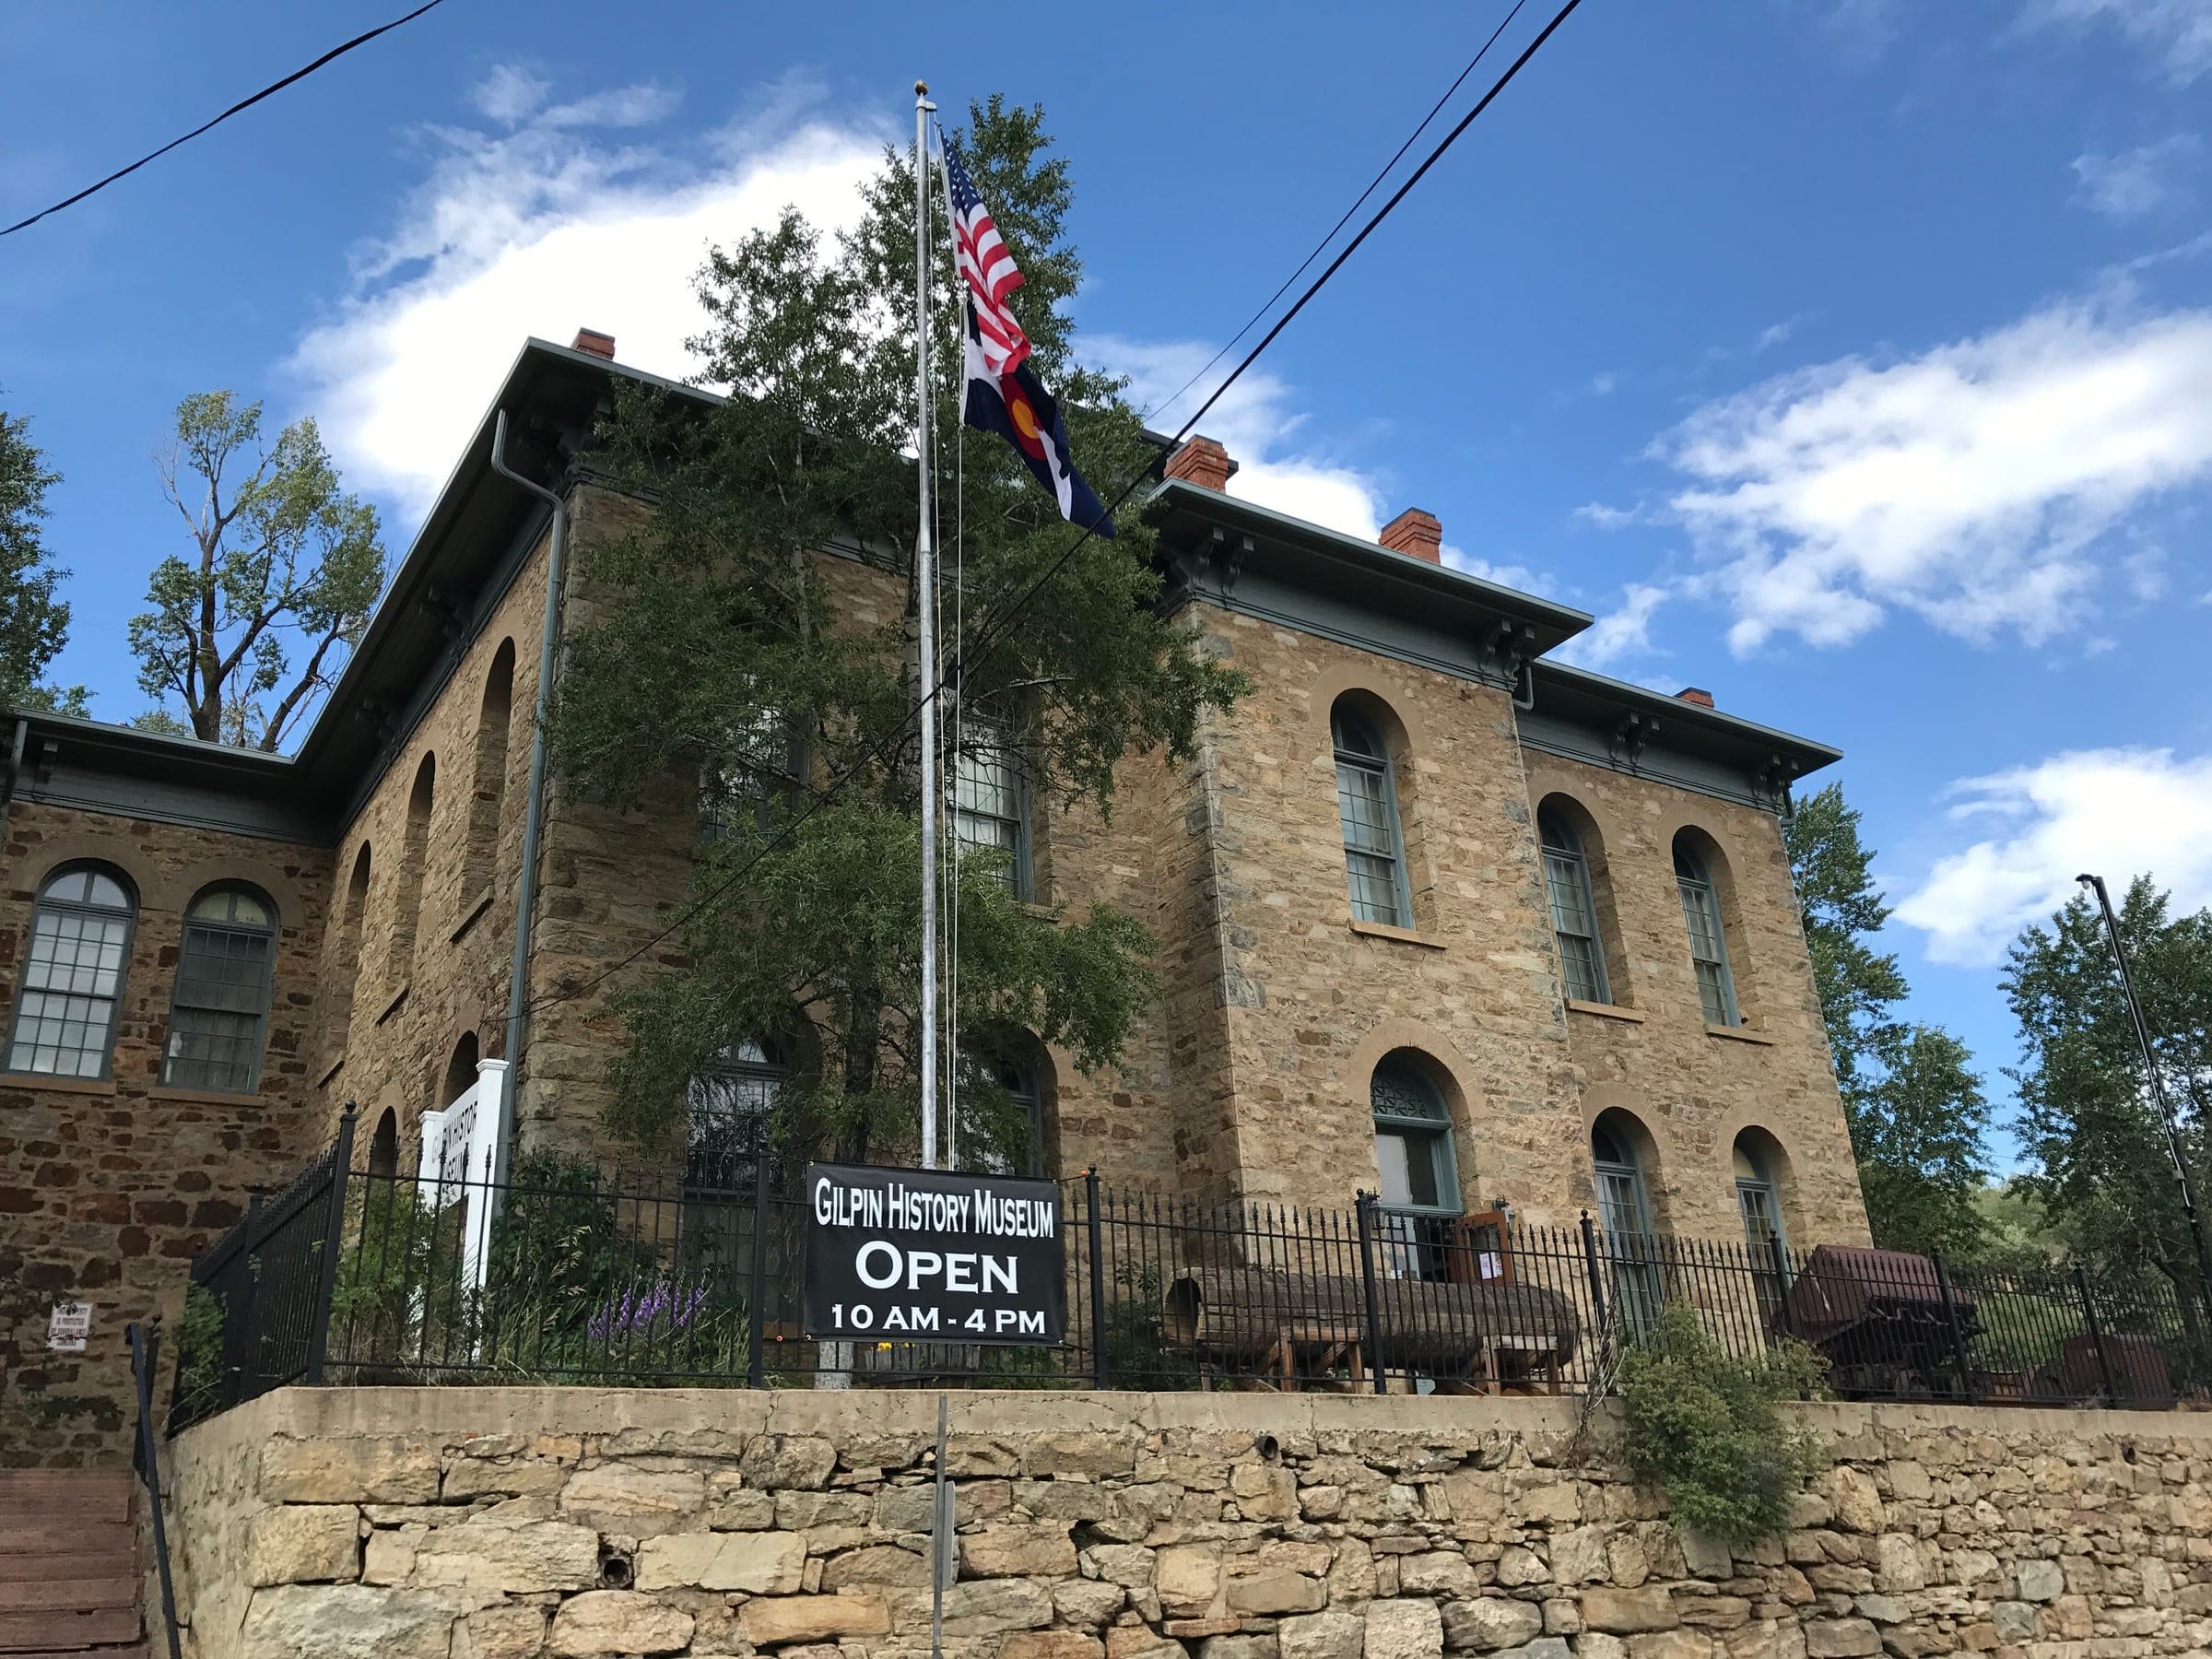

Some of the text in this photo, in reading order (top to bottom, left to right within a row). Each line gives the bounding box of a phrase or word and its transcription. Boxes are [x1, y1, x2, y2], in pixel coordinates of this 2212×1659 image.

[453, 1100, 479, 1147] HISTOR
[816, 1178, 1053, 1238] GILPIN HISTORY MUSEUM
[856, 1241, 1018, 1293] OPEN
[832, 1304, 873, 1328] 10
[883, 1306, 939, 1330] AM
[965, 1309, 986, 1332] 4
[995, 1310, 1044, 1334] PM
